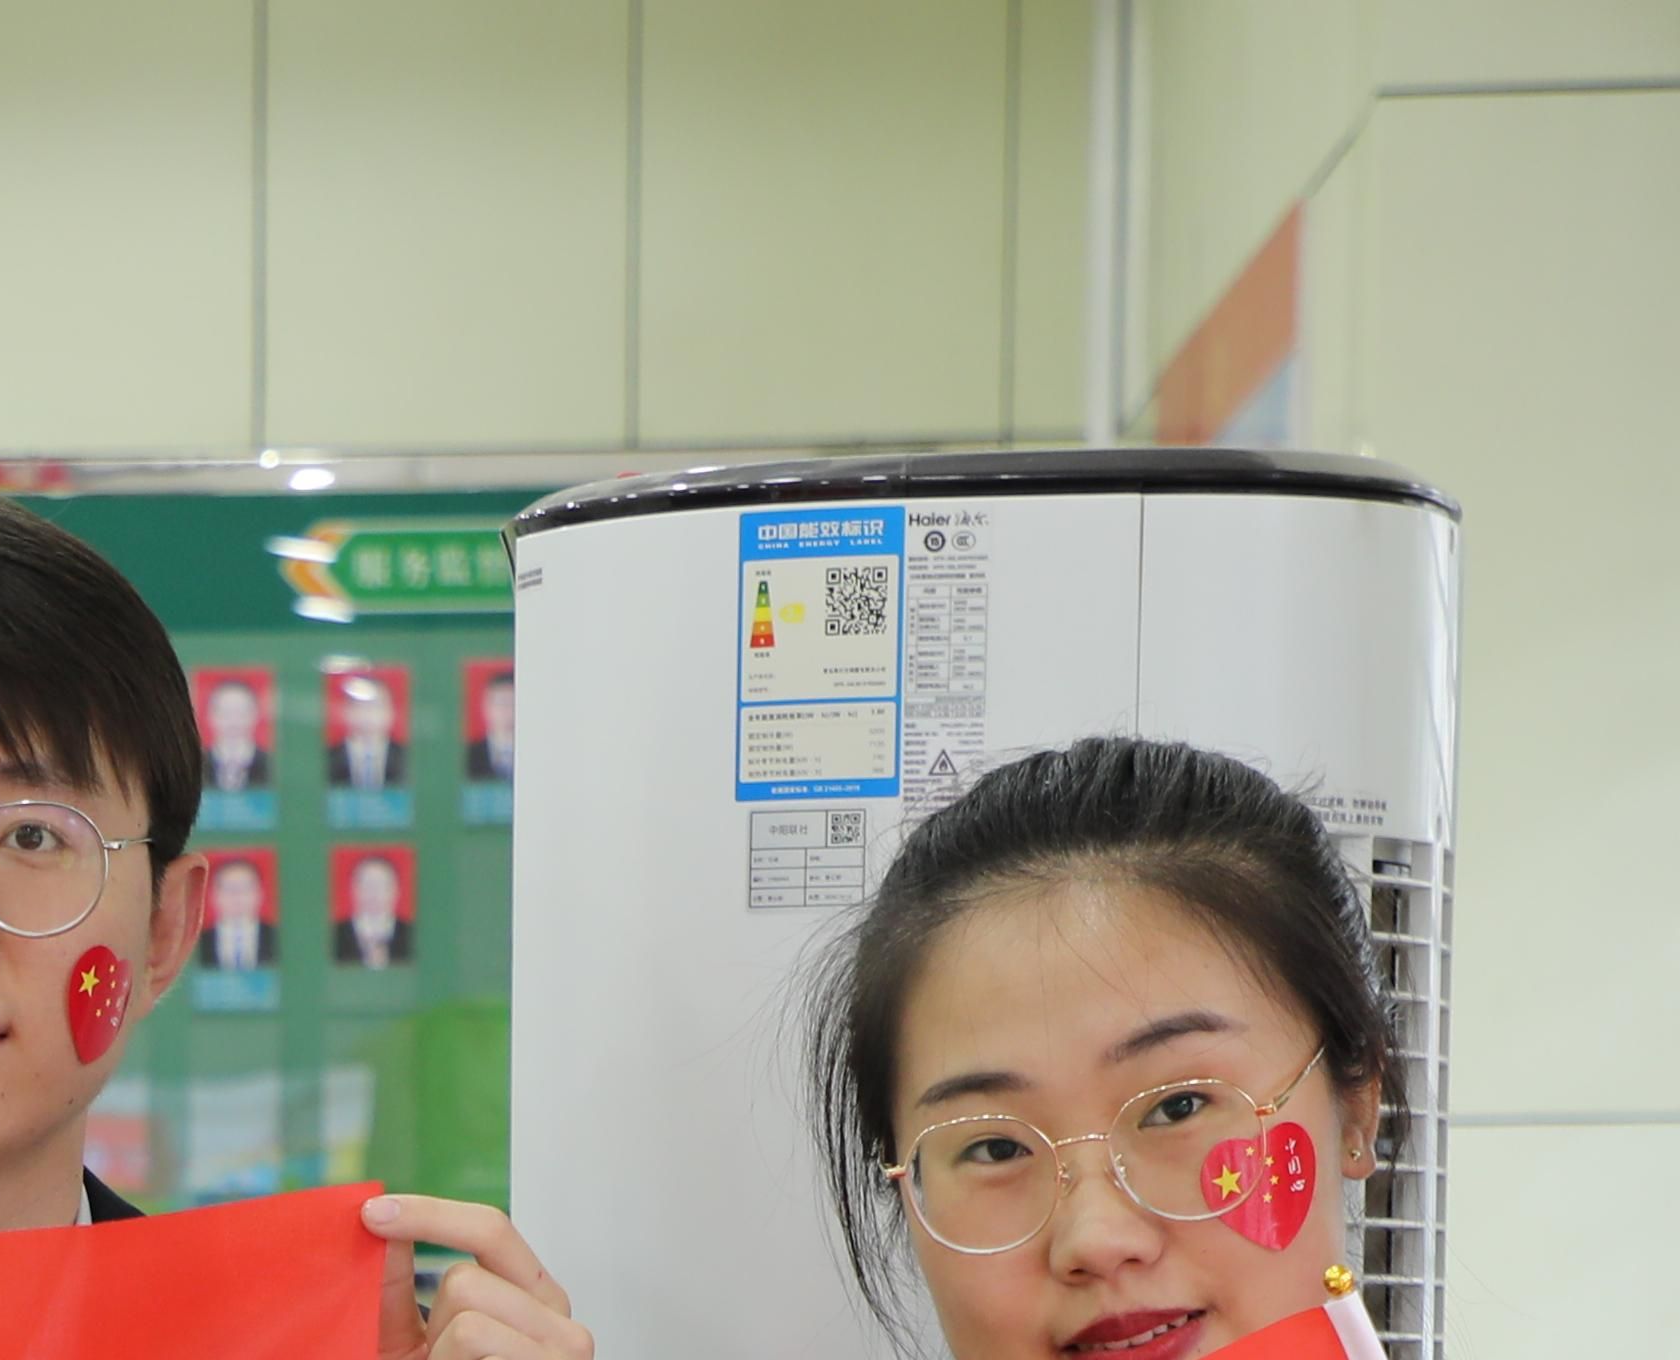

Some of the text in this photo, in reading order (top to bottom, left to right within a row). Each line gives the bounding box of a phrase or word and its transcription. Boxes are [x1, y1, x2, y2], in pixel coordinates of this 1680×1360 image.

[908, 512, 951, 527] Haier
[758, 519, 885, 541] 中国能效标识
